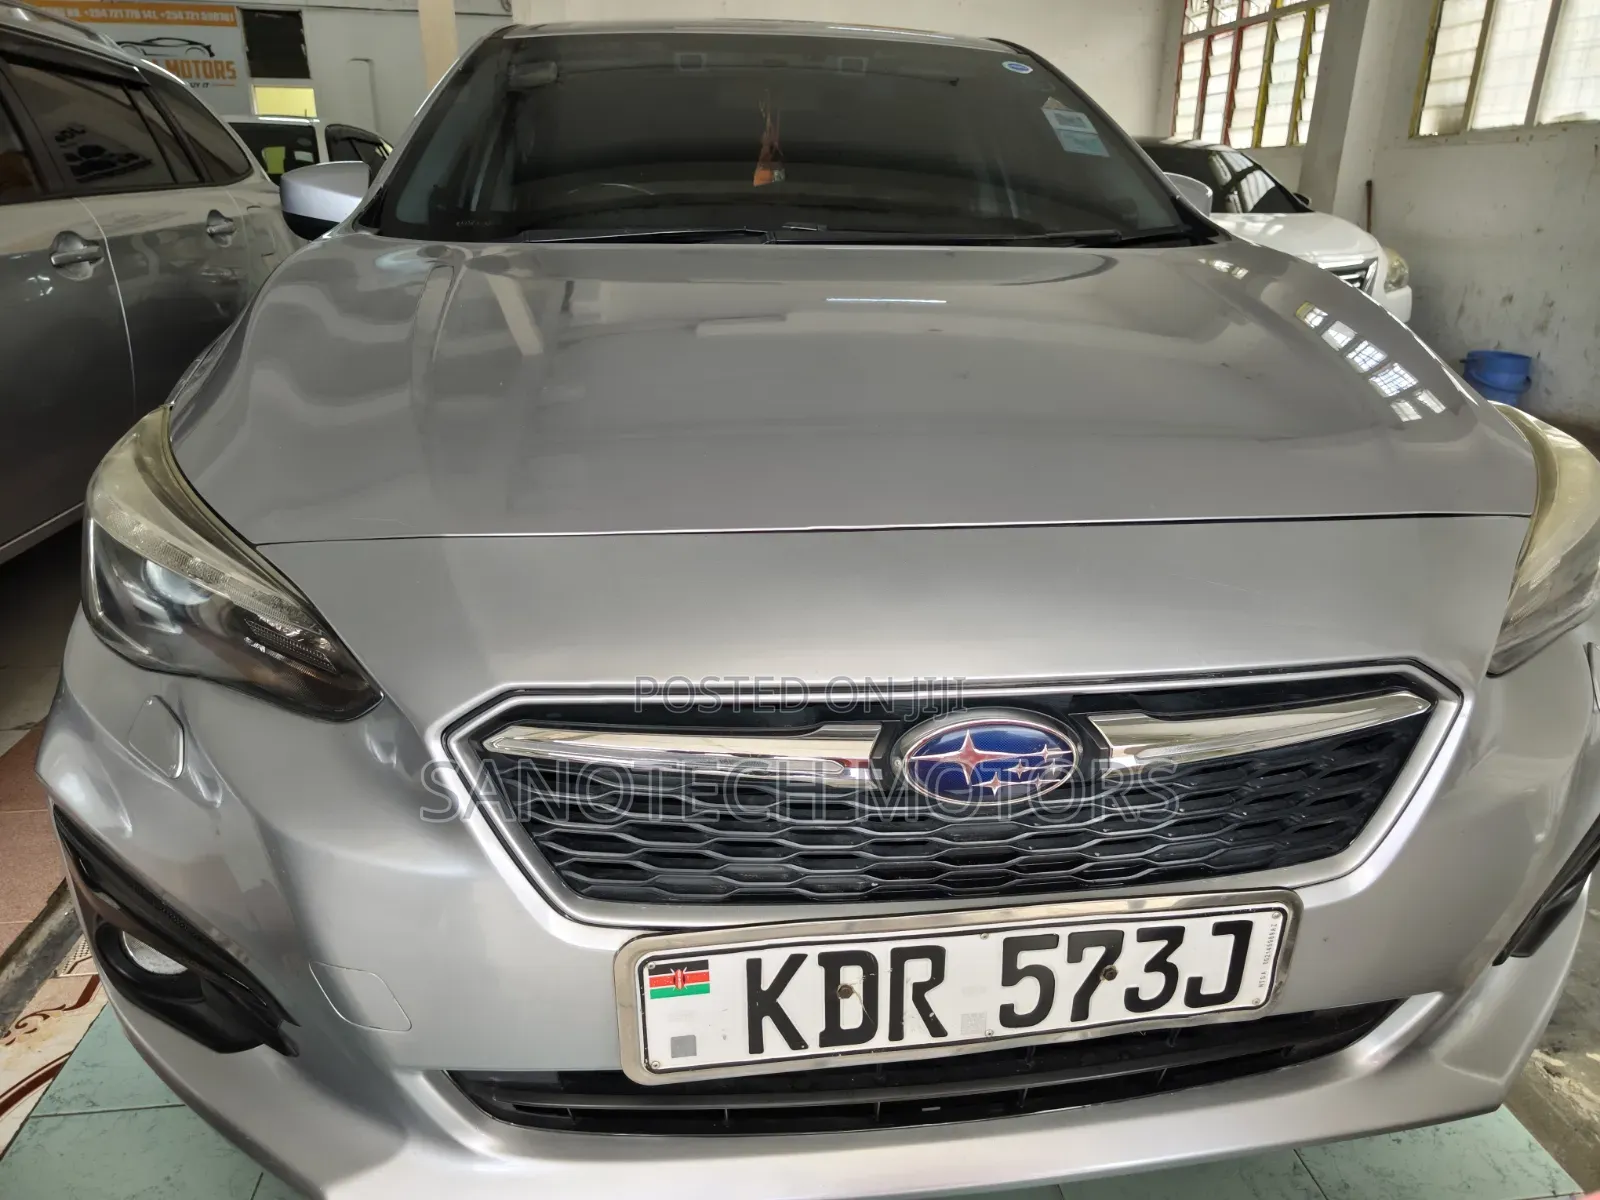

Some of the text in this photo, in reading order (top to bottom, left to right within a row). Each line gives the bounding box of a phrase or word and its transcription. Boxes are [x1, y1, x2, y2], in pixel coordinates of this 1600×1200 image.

[165, 59, 237, 80] MOTORS
[745, 919, 1253, 1055] KDR 573J
